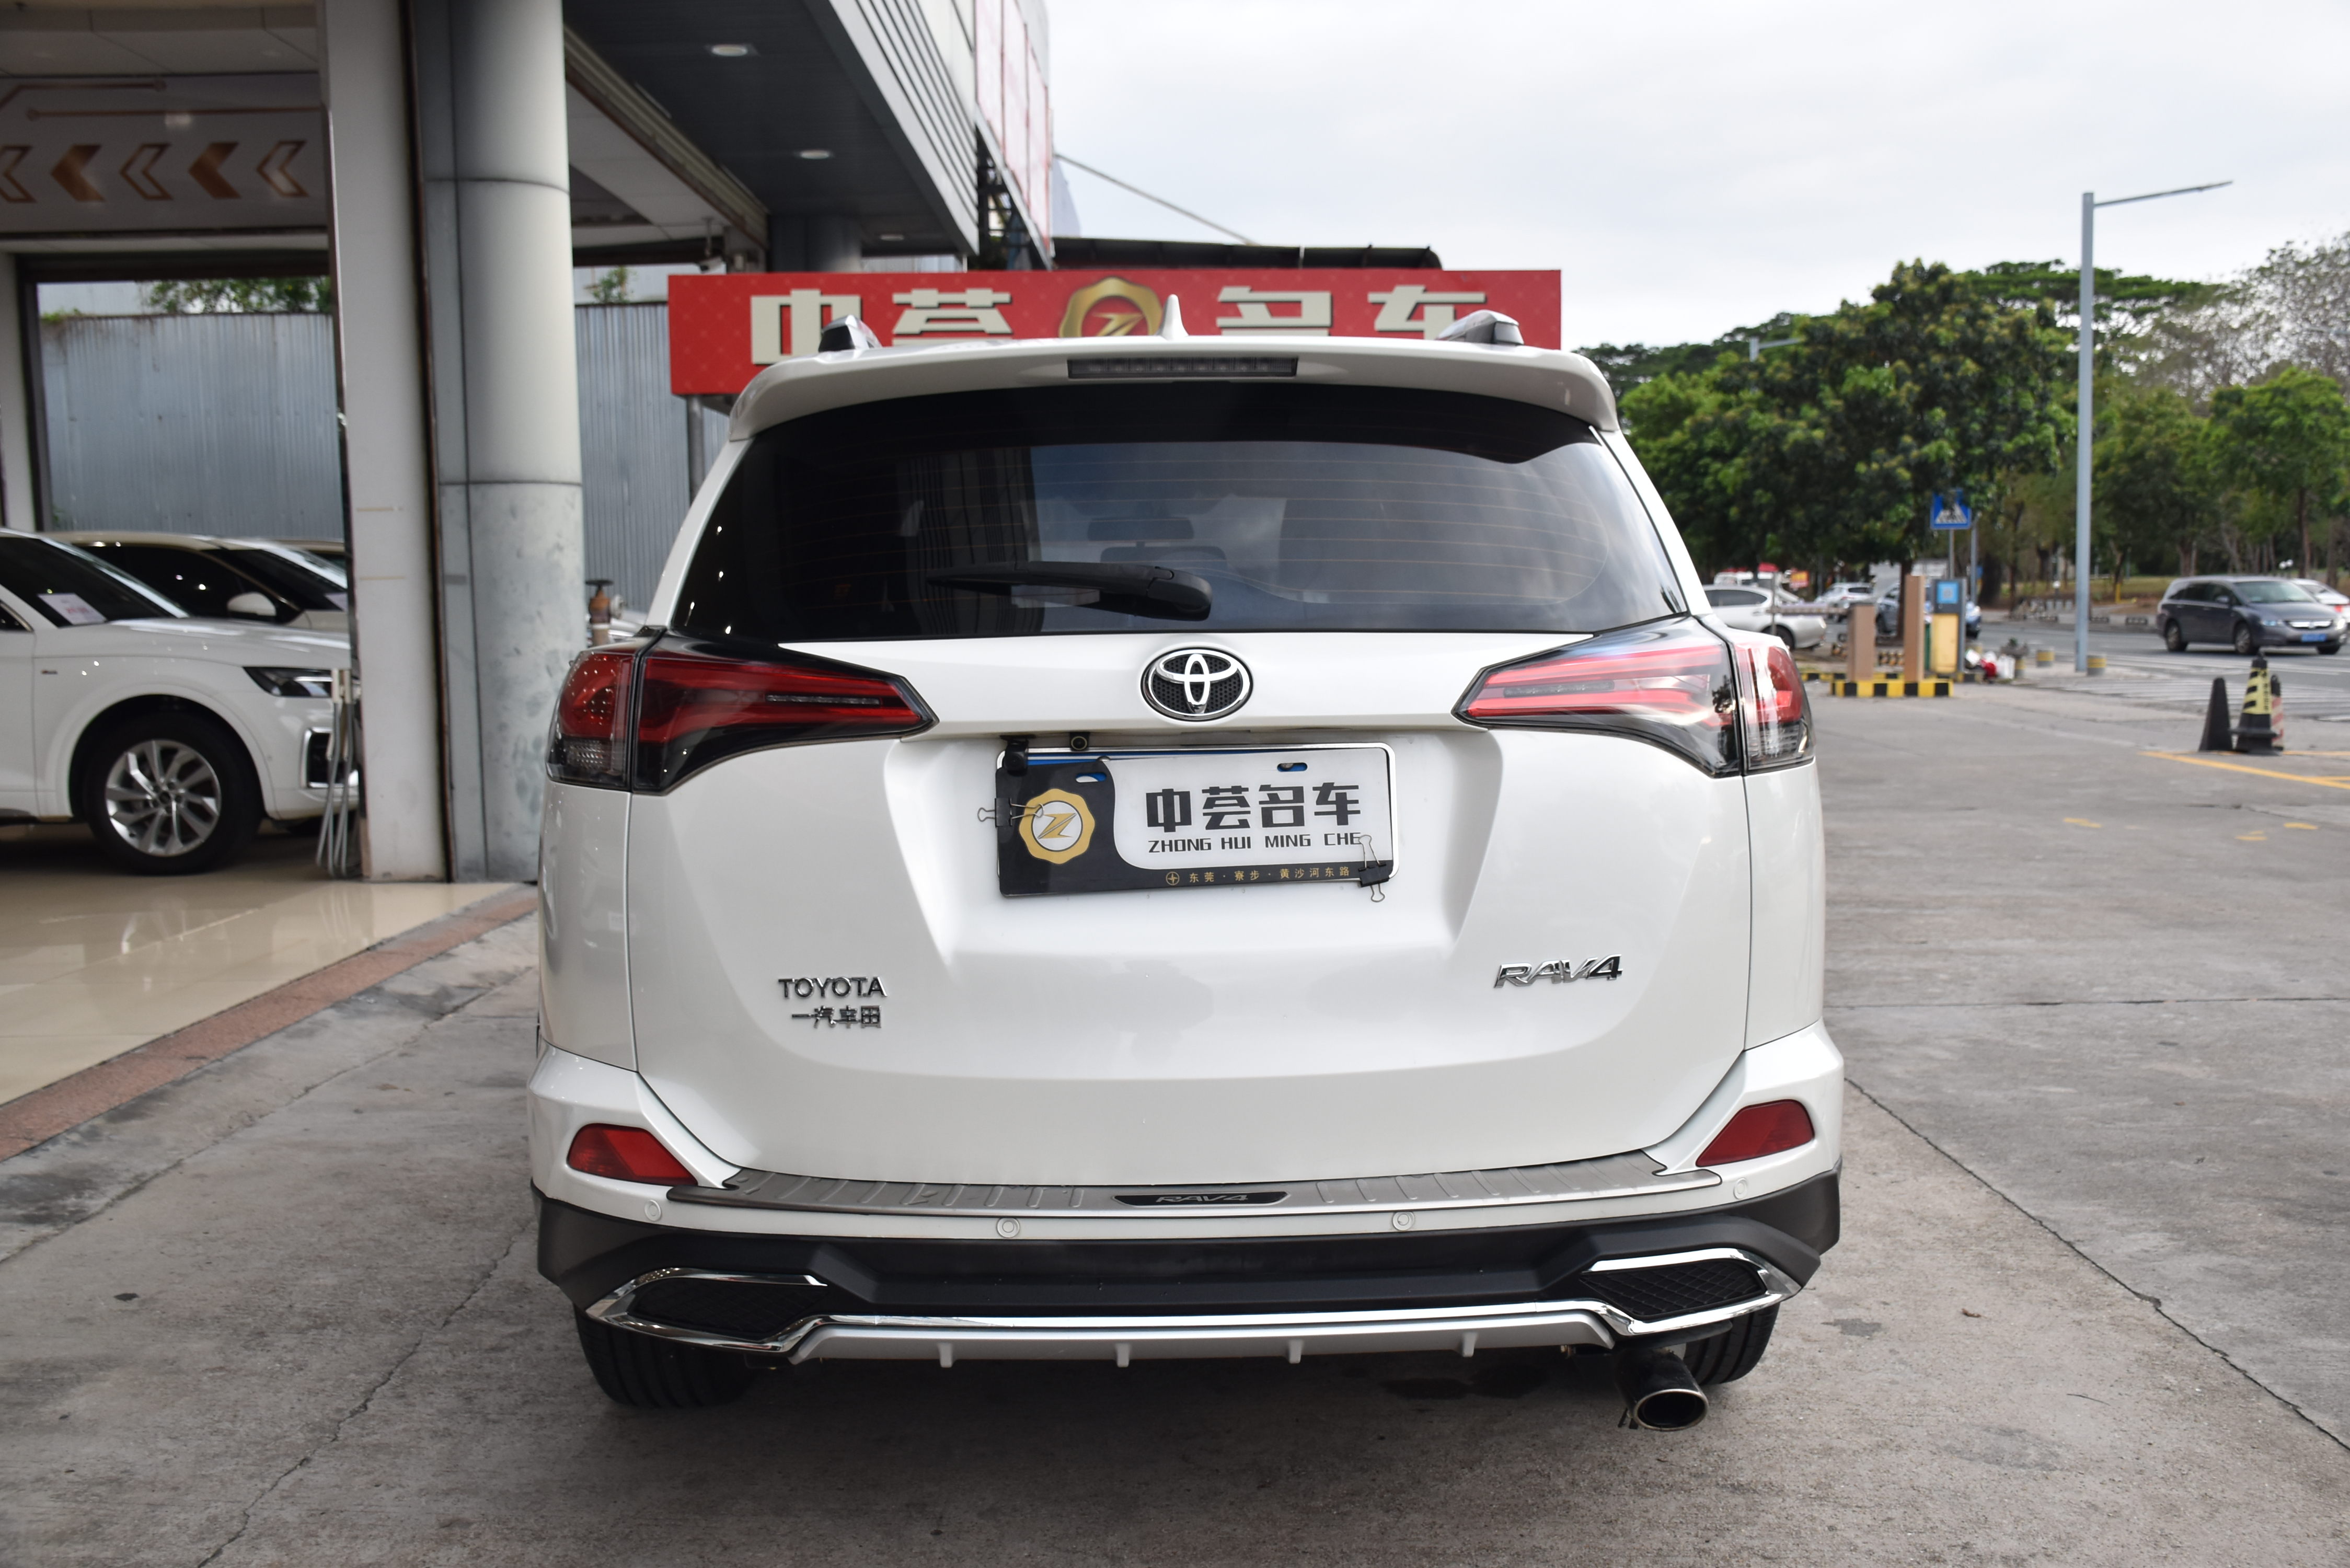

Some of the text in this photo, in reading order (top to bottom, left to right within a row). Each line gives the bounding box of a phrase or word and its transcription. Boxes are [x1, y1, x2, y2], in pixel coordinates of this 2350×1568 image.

[1146, 782, 1361, 833] 中荟名车
[1148, 832, 1362, 853] ZHONG HUI MING CHE
[1493, 954, 1623, 988] RAV4
[778, 976, 888, 999] TOYOTA
[791, 1005, 882, 1029] 一汽丰田
[1156, 1194, 1249, 1203] RAV4
